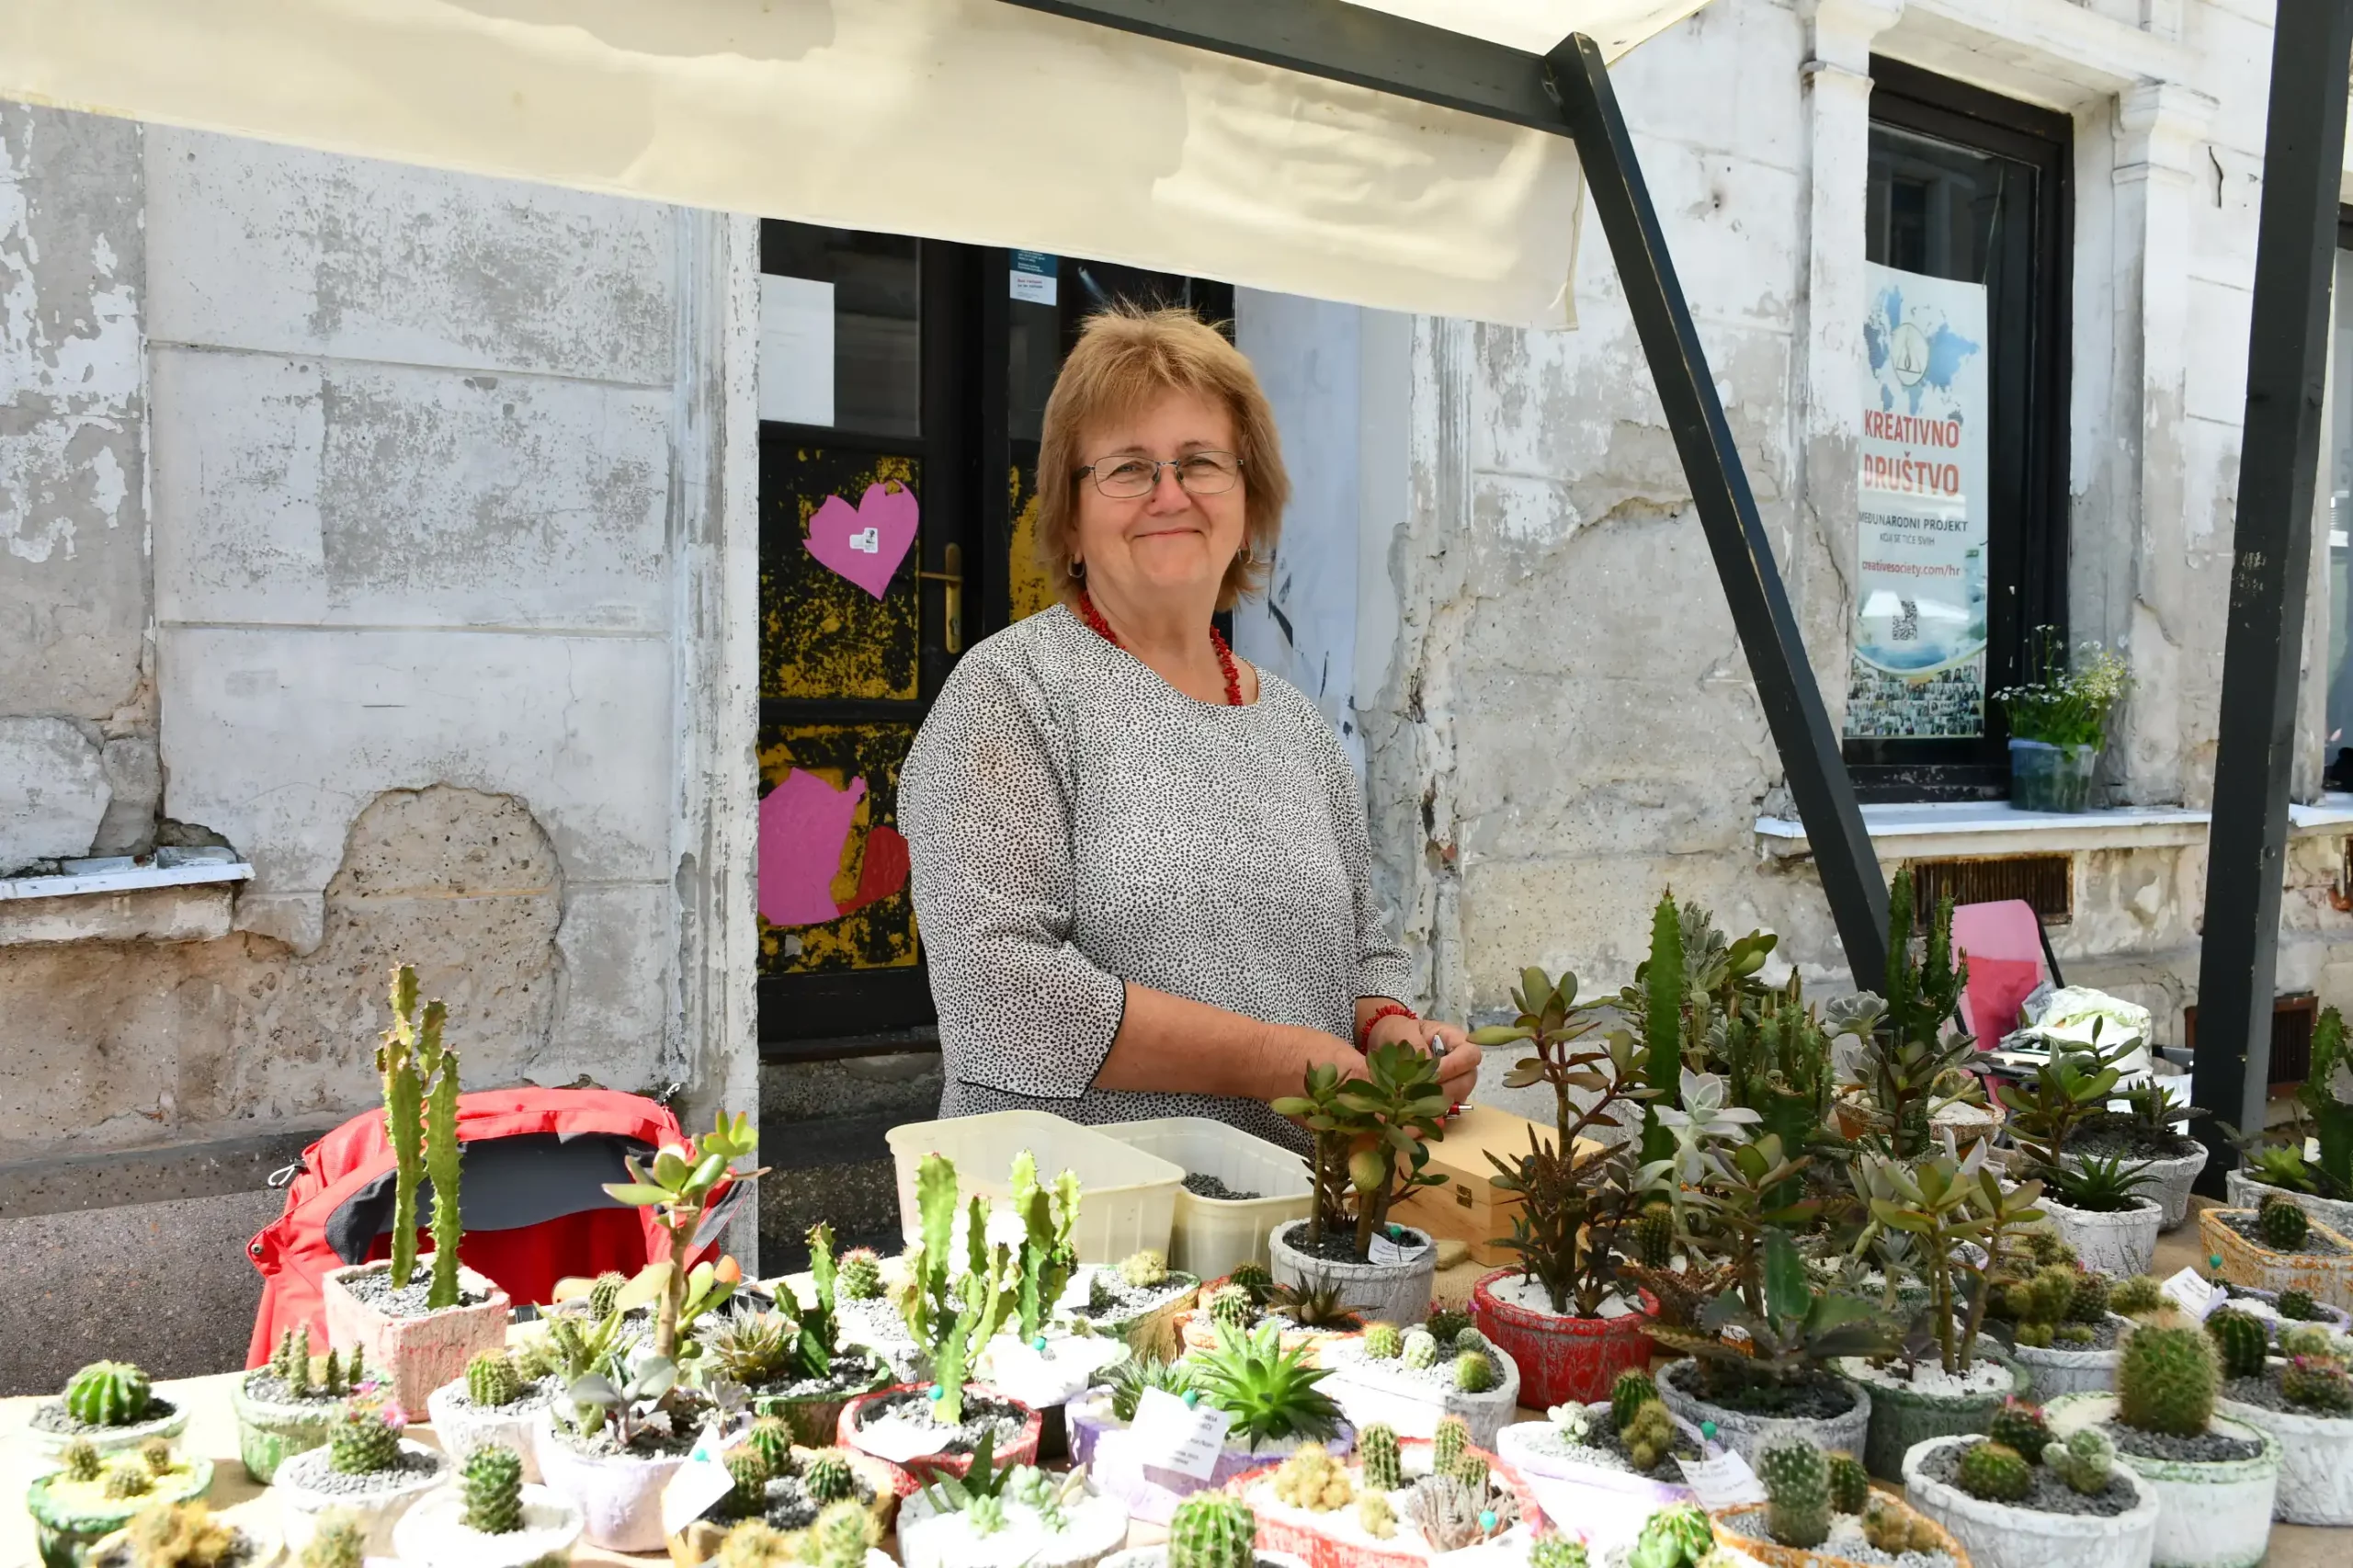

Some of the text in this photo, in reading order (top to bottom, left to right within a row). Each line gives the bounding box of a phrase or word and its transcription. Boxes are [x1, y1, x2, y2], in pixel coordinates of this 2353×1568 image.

[1864, 409, 1960, 449] KREATIVNO
[1864, 450, 1960, 496] DRUŠTVO
[1924, 518, 1968, 532] PROJEKT
[1917, 536, 1935, 546] SVIH
[1861, 559, 1961, 577] creativesociety.com/hr
